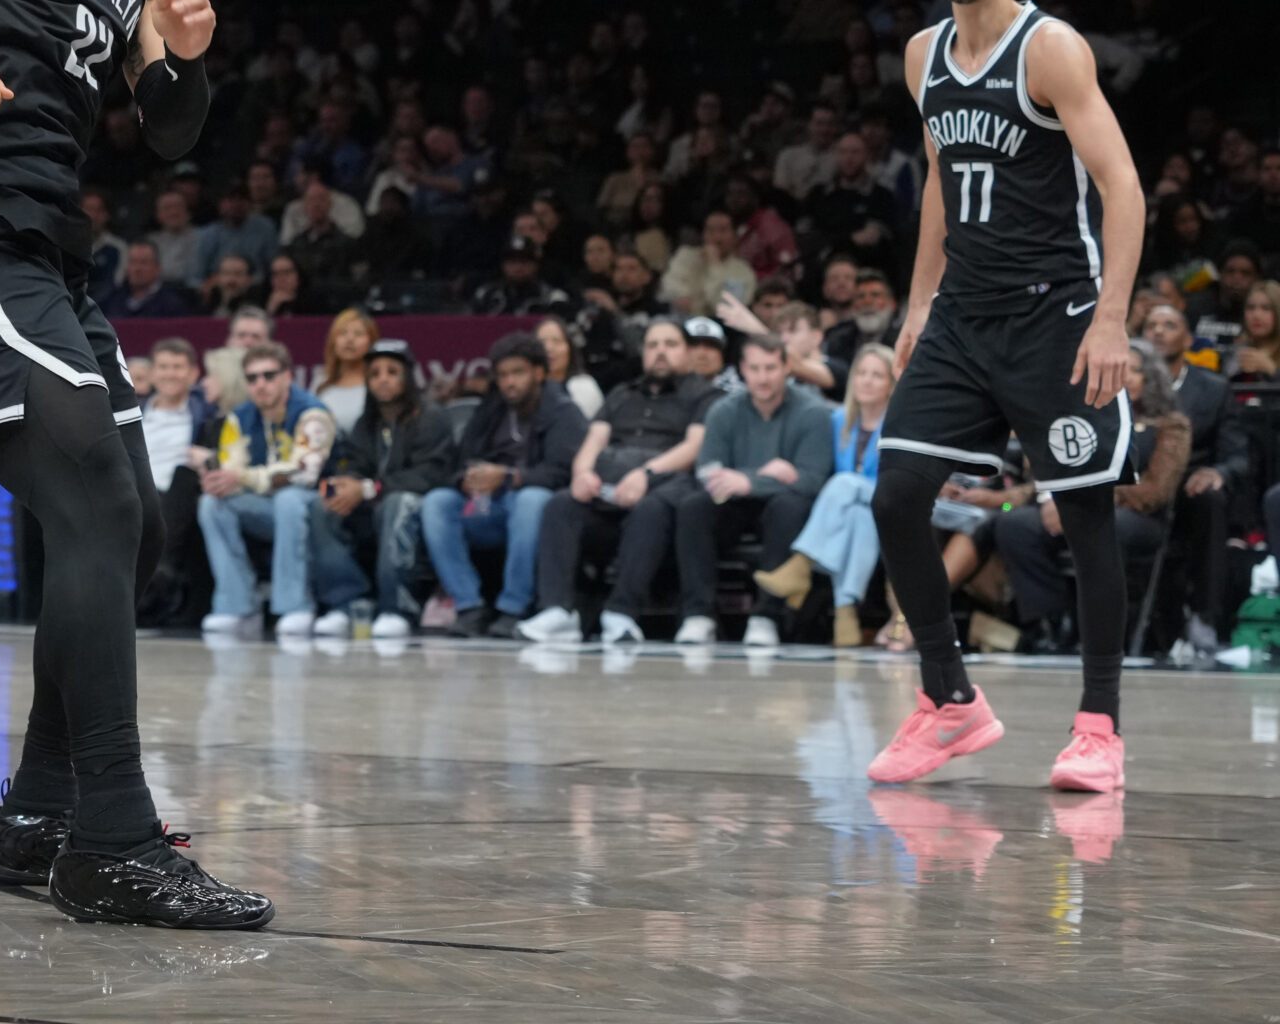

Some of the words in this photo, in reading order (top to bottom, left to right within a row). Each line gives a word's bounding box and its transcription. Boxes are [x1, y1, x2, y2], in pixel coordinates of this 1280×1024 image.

[64, 4, 114, 91] 22
[927, 108, 1028, 158] ROOKLYN
[951, 162, 995, 223] 77
[1062, 423, 1080, 459] B
